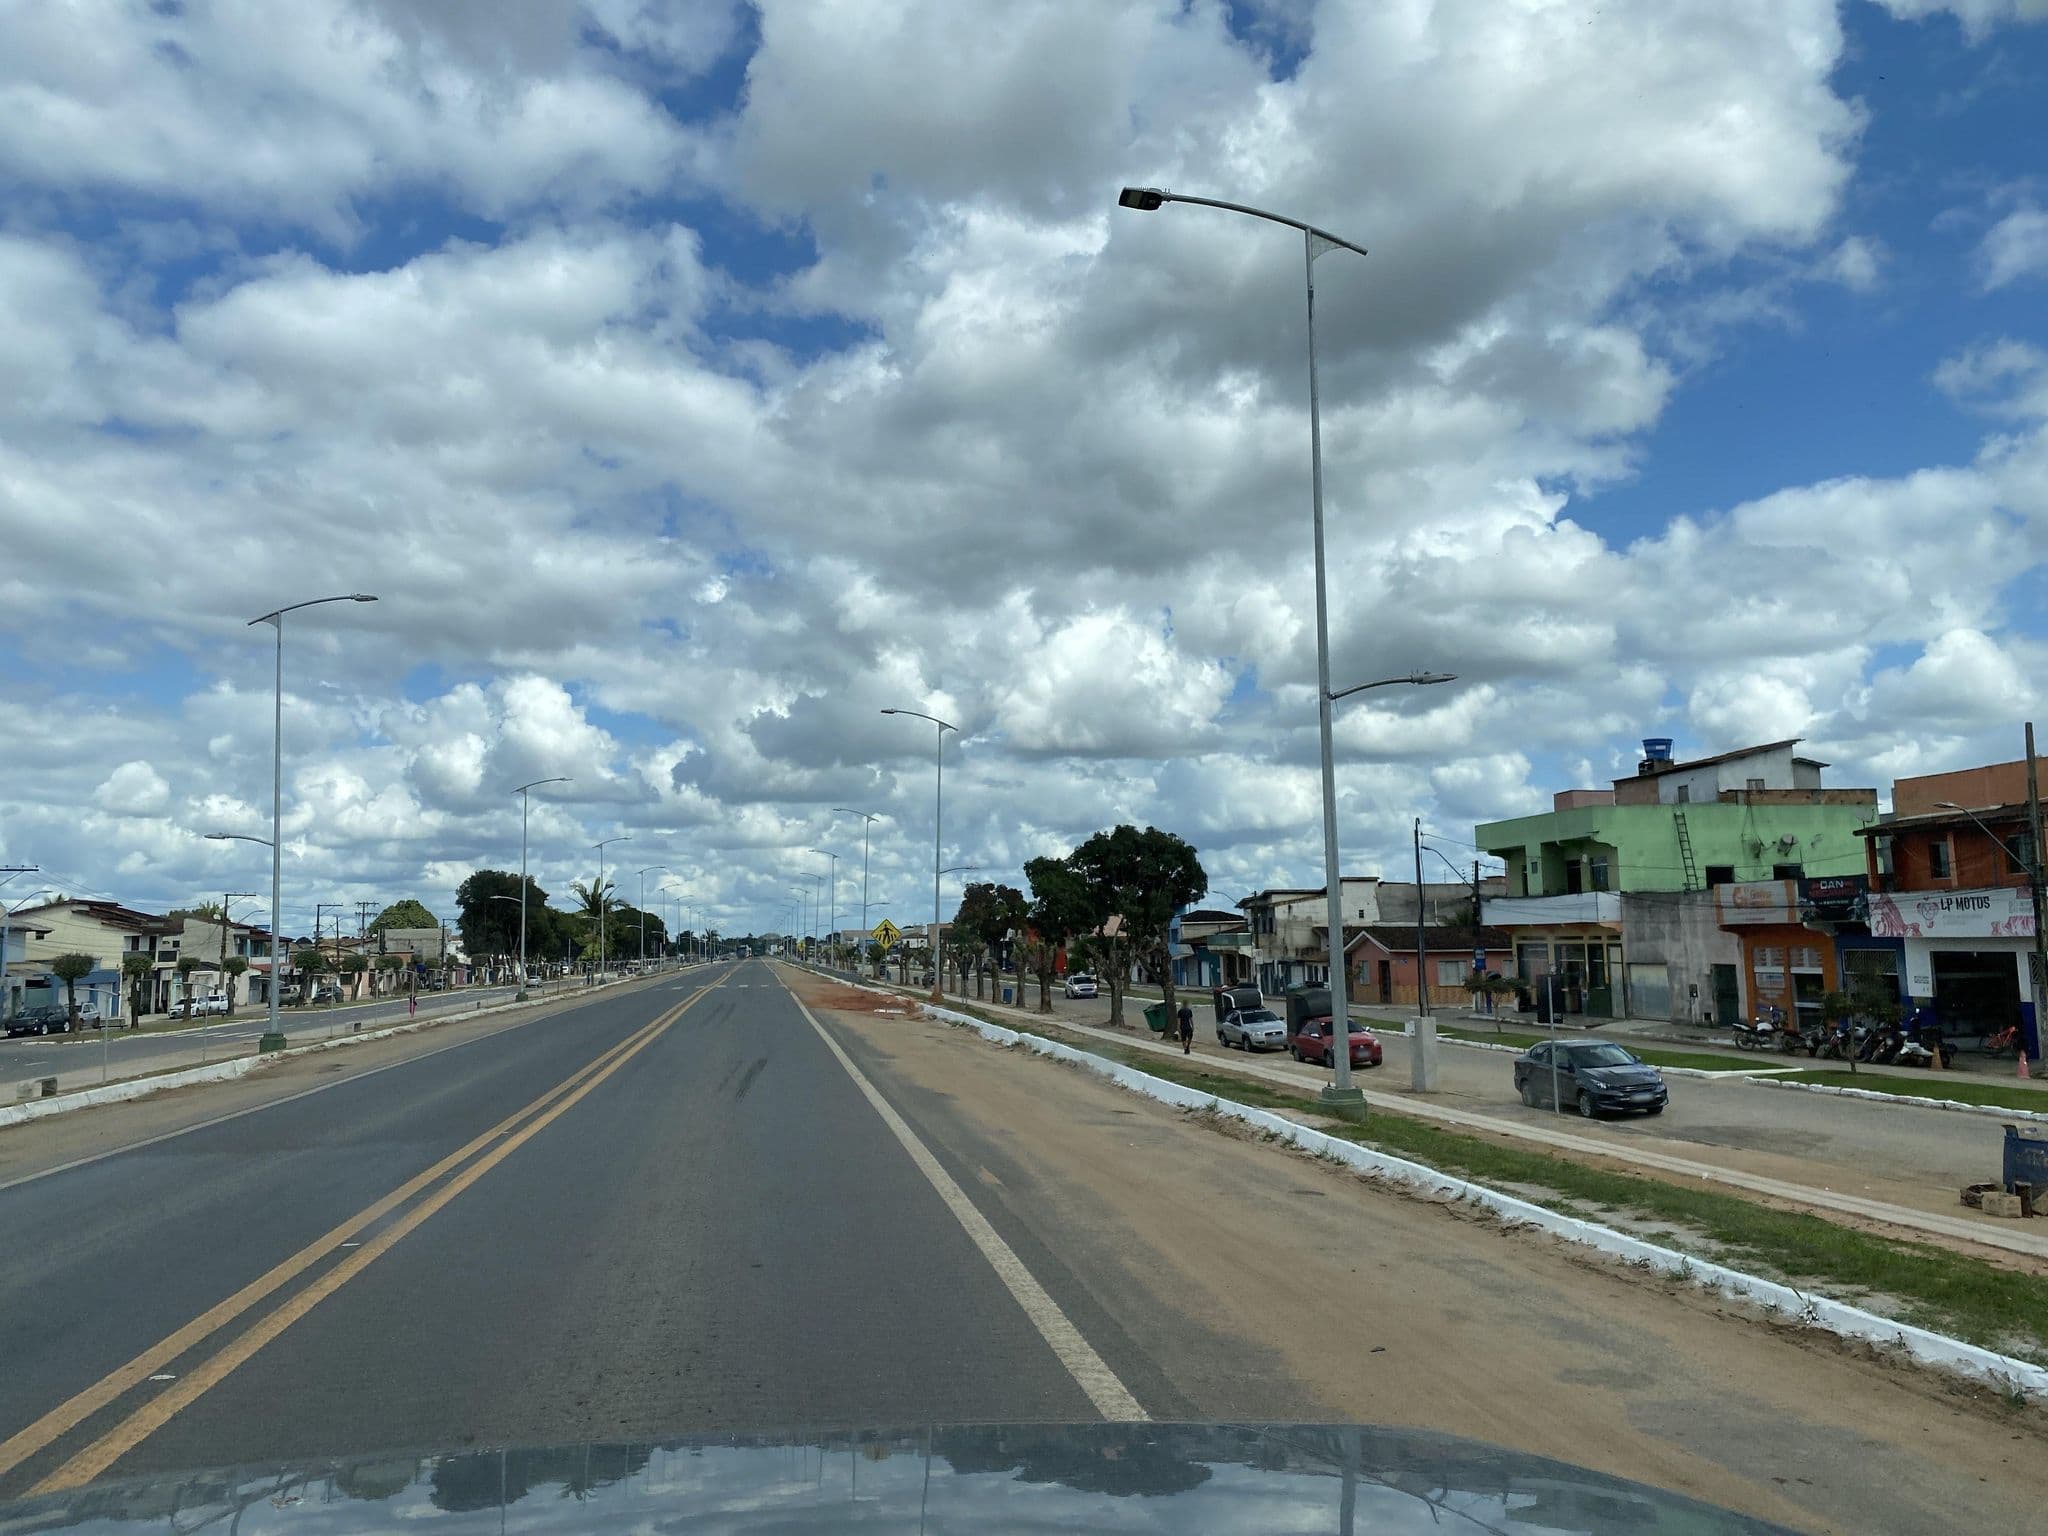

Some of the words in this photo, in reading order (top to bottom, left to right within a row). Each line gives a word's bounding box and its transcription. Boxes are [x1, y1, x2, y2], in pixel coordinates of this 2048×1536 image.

[1820, 880, 1844, 889] DAN
[1940, 898, 1953, 912] LP
[1956, 896, 1991, 911] MOTOS
